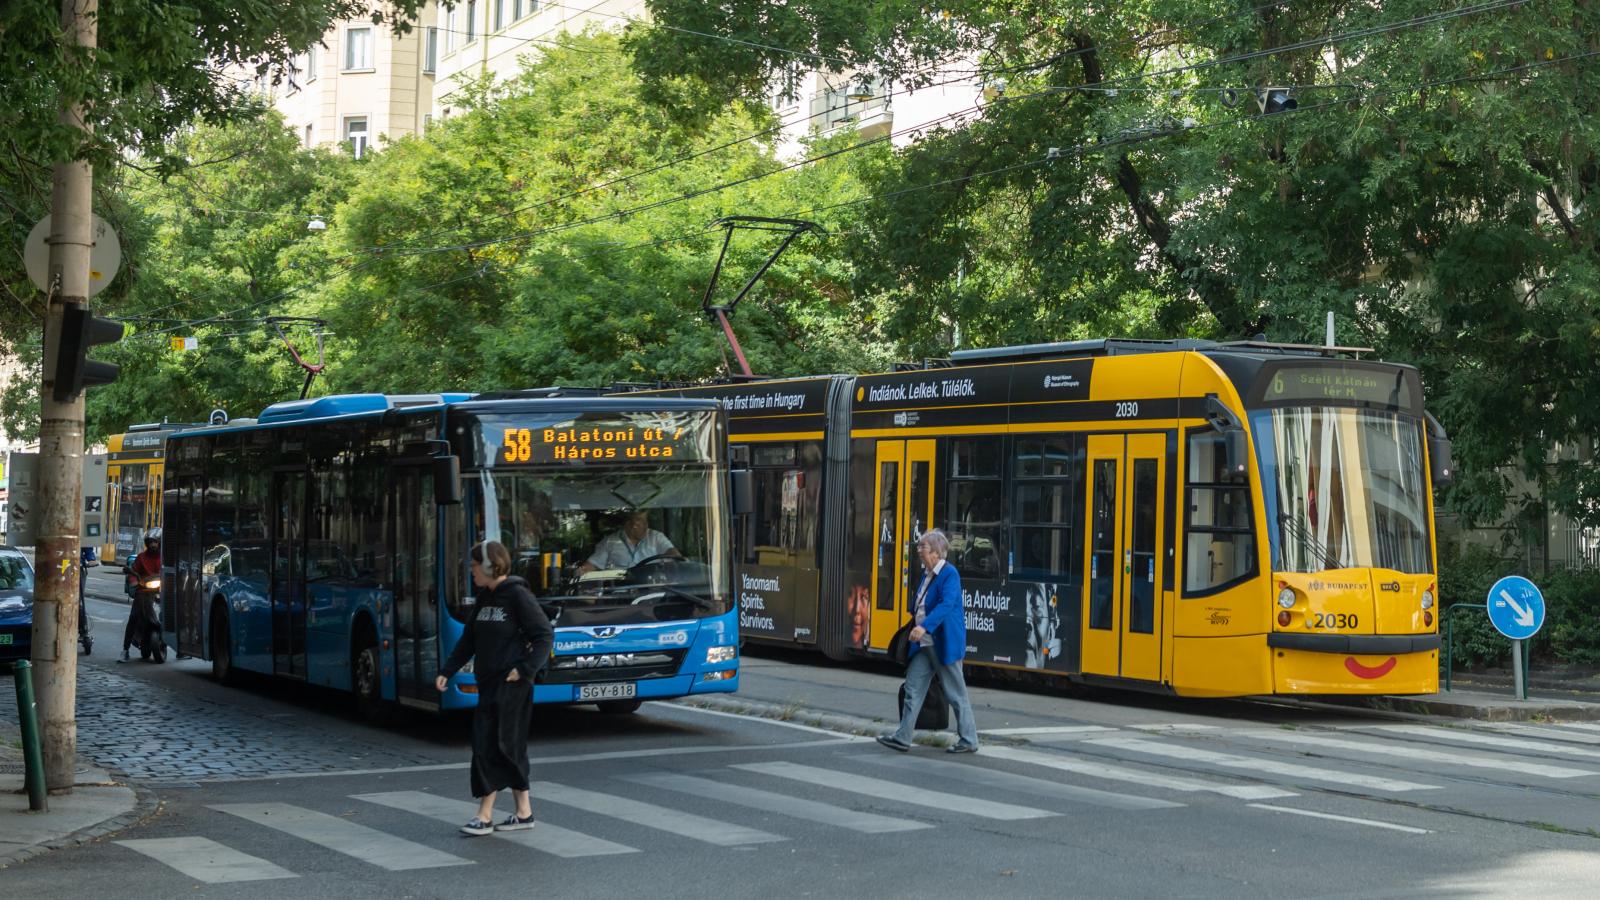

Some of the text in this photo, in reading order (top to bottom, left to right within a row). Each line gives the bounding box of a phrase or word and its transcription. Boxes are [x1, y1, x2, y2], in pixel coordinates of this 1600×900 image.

[1273, 370, 1284, 394] 6
[1301, 374, 1377, 388] Széll Kálmán
[868, 378, 976, 402] Indiánok. Lelkek. Túlélők.
[723, 392, 806, 410] the first time in Hungary
[1115, 401, 1139, 417] 2030
[543, 428, 635, 443] Balatoni
[643, 427, 664, 441] út
[504, 428, 531, 462] 58
[554, 444, 673, 459] Háros utca
[741, 573, 780, 592] Yanomami.
[1327, 582, 1368, 590] BUDAPEST
[741, 592, 765, 611] Spirits.
[973, 589, 1011, 613] Andujar
[740, 611, 775, 630] Survivors.
[1314, 612, 1359, 629] 2030
[576, 653, 635, 668] MAN
[583, 685, 633, 698] SGY-818
